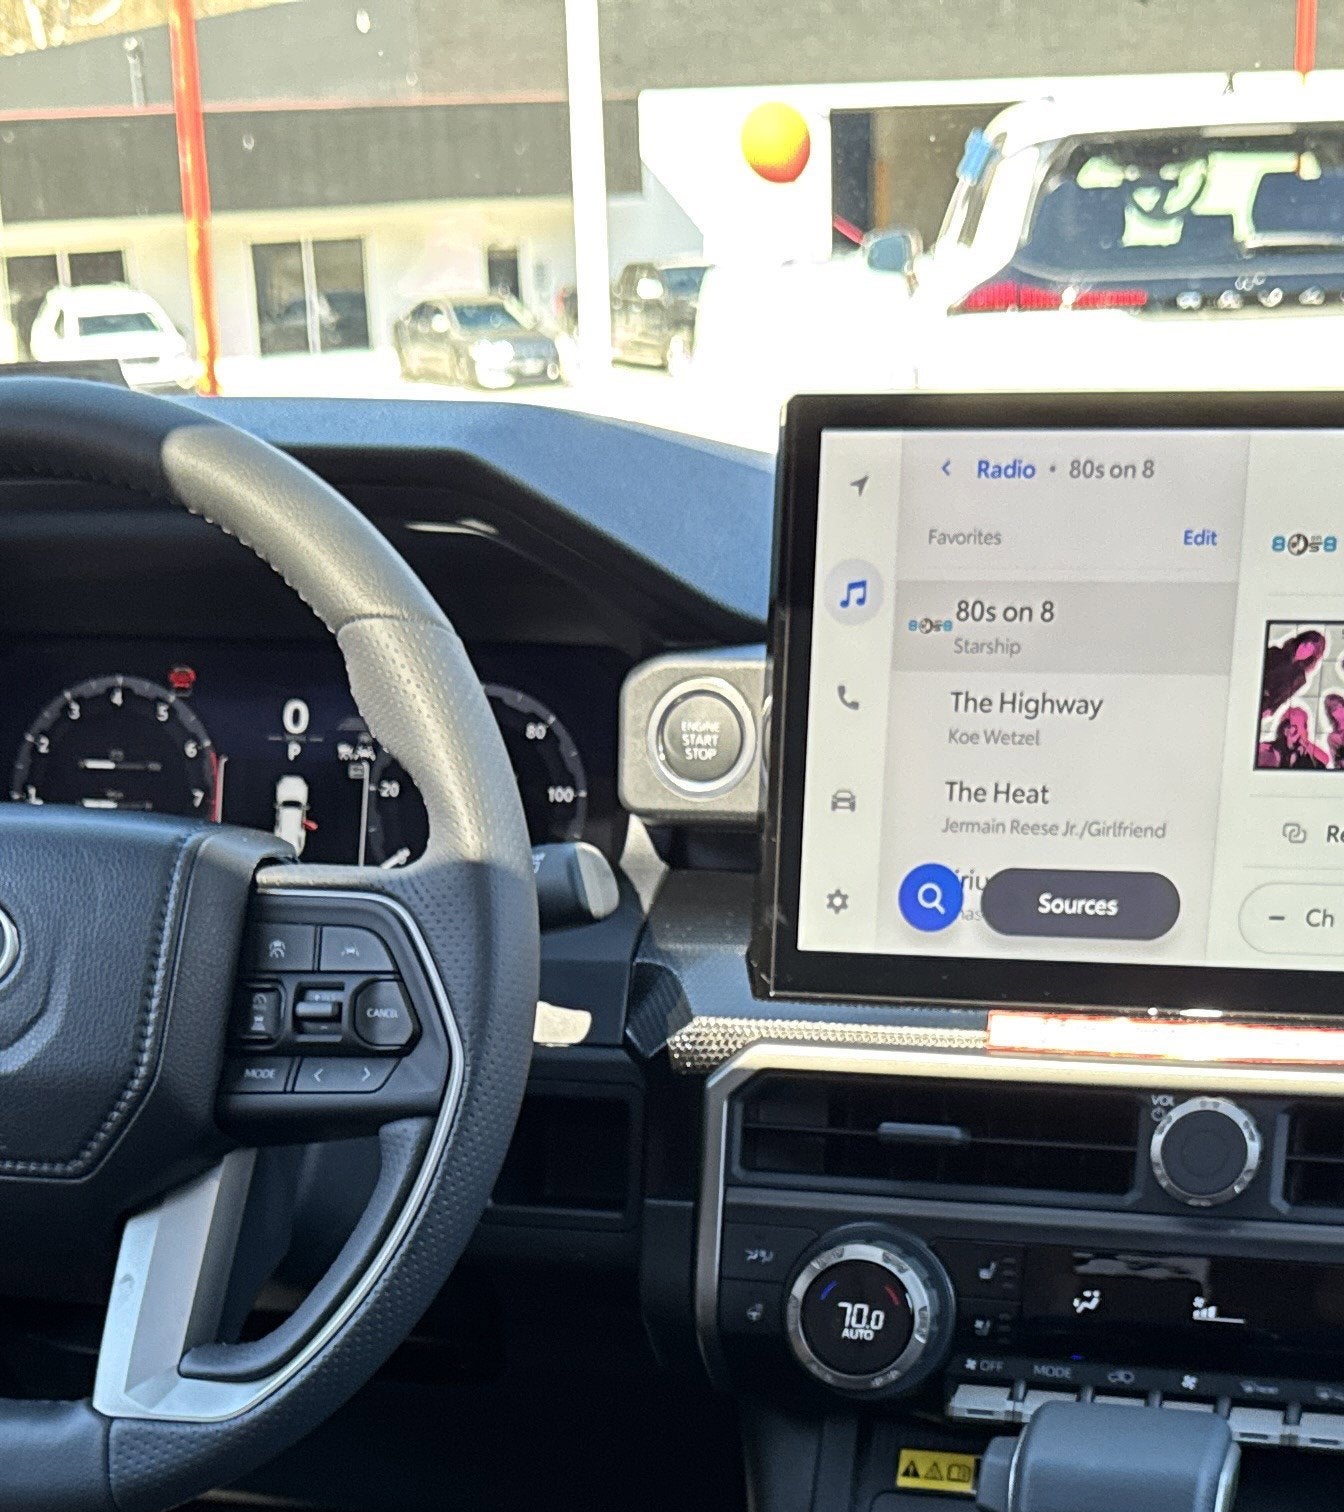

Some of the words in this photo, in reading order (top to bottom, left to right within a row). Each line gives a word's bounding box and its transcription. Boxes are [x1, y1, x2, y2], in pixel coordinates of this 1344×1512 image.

[977, 458, 1036, 480] Radio
[1069, 459, 1104, 480] 80s
[1109, 464, 1136, 480] on
[1141, 459, 1155, 480] 8
[928, 528, 1002, 547] Favorites
[1183, 529, 1218, 547] Edit
[955, 600, 997, 623] 80s
[1002, 607, 1034, 623] on
[1040, 600, 1055, 623] 8
[953, 638, 1022, 658] Starship
[68, 701, 81, 720] 3
[156, 702, 170, 722] 5
[950, 690, 993, 715] The
[999, 692, 1104, 720] Highway
[282, 697, 310, 735] 0
[524, 721, 547, 740] 80
[681, 734, 719, 747] START
[948, 728, 981, 746] Koe
[984, 728, 1041, 747] Wetzel
[36, 734, 50, 754] 2
[184, 740, 198, 759] 6
[287, 740, 302, 762] P
[684, 748, 718, 761] STOP
[379, 779, 400, 799] 20
[547, 785, 575, 803] 100
[945, 781, 987, 804] The
[992, 783, 1050, 806] Heat
[941, 816, 1006, 836] Jermain
[1010, 819, 1059, 837] Reese
[1037, 891, 1120, 917] Sources
[1305, 908, 1335, 929] Ch
[837, 1301, 885, 1332] 70.0
[840, 1327, 875, 1342] AUTO
[1033, 1364, 1072, 1379] MODE
